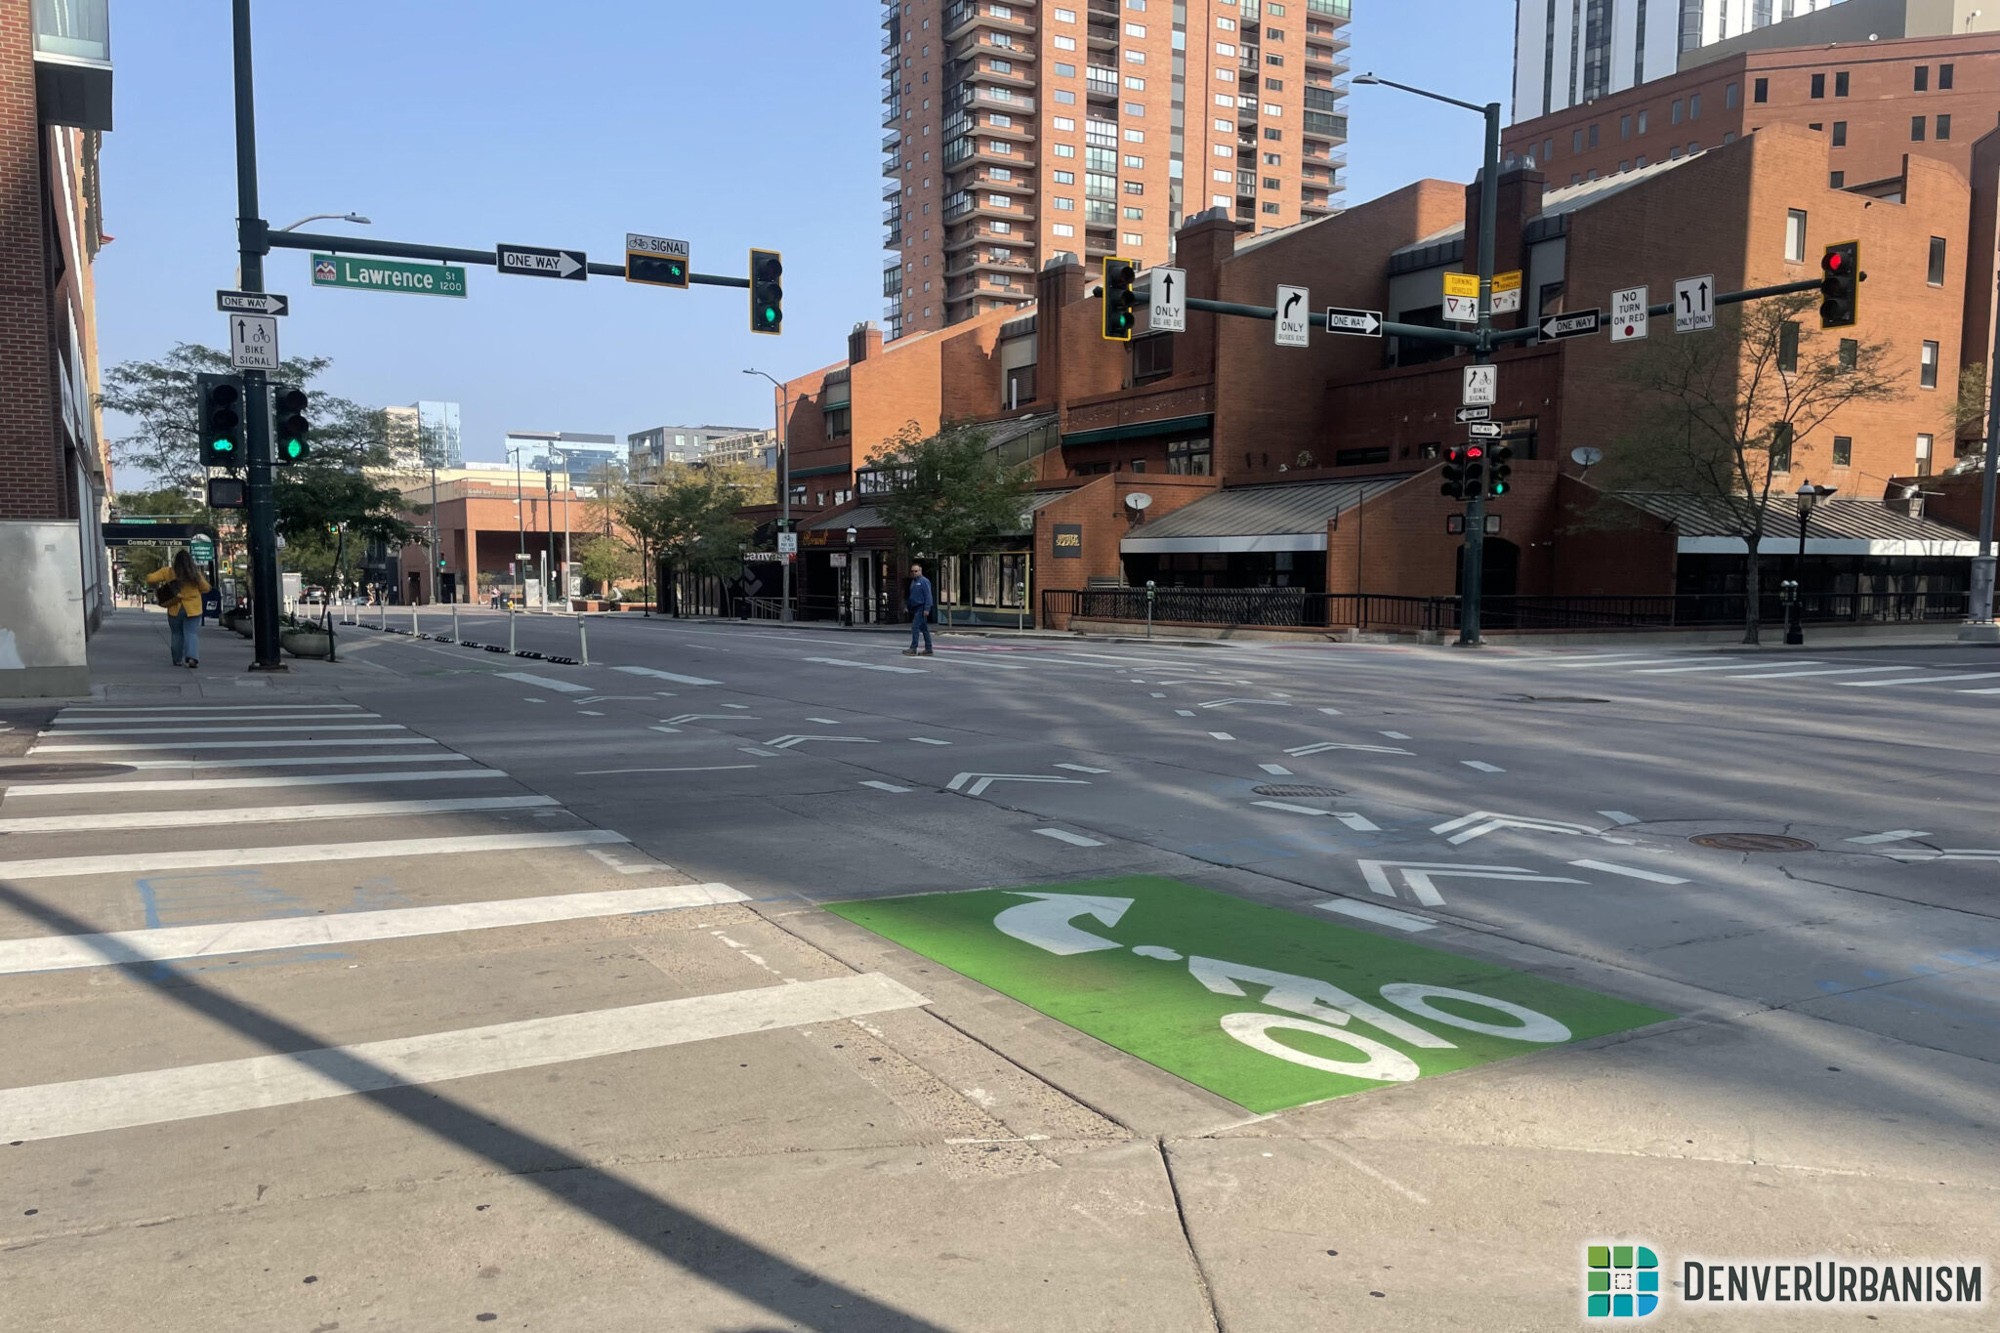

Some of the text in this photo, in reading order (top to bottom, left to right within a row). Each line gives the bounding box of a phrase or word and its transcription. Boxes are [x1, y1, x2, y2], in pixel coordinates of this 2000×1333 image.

[650, 239, 686, 255] SIGNAL
[507, 253, 560, 270] ONE WAY
[345, 262, 433, 289] Lawrence
[445, 271, 455, 281] St
[440, 281, 462, 291] 1200
[224, 296, 266, 308] ONE WAY
[1622, 291, 1637, 302] NO
[1155, 305, 1180, 318] ONLY
[1619, 303, 1641, 314] TURN
[1333, 315, 1366, 328] ONE WAY
[1557, 317, 1594, 332] ONE WAY
[1614, 312, 1645, 326] ON RED
[1677, 313, 1712, 327] ONLY ONLY
[1281, 321, 1304, 332] ONLY
[244, 345, 265, 355] BIKE
[240, 355, 271, 366] SIGNAL
[1469, 394, 1489, 402] SIGNAL
